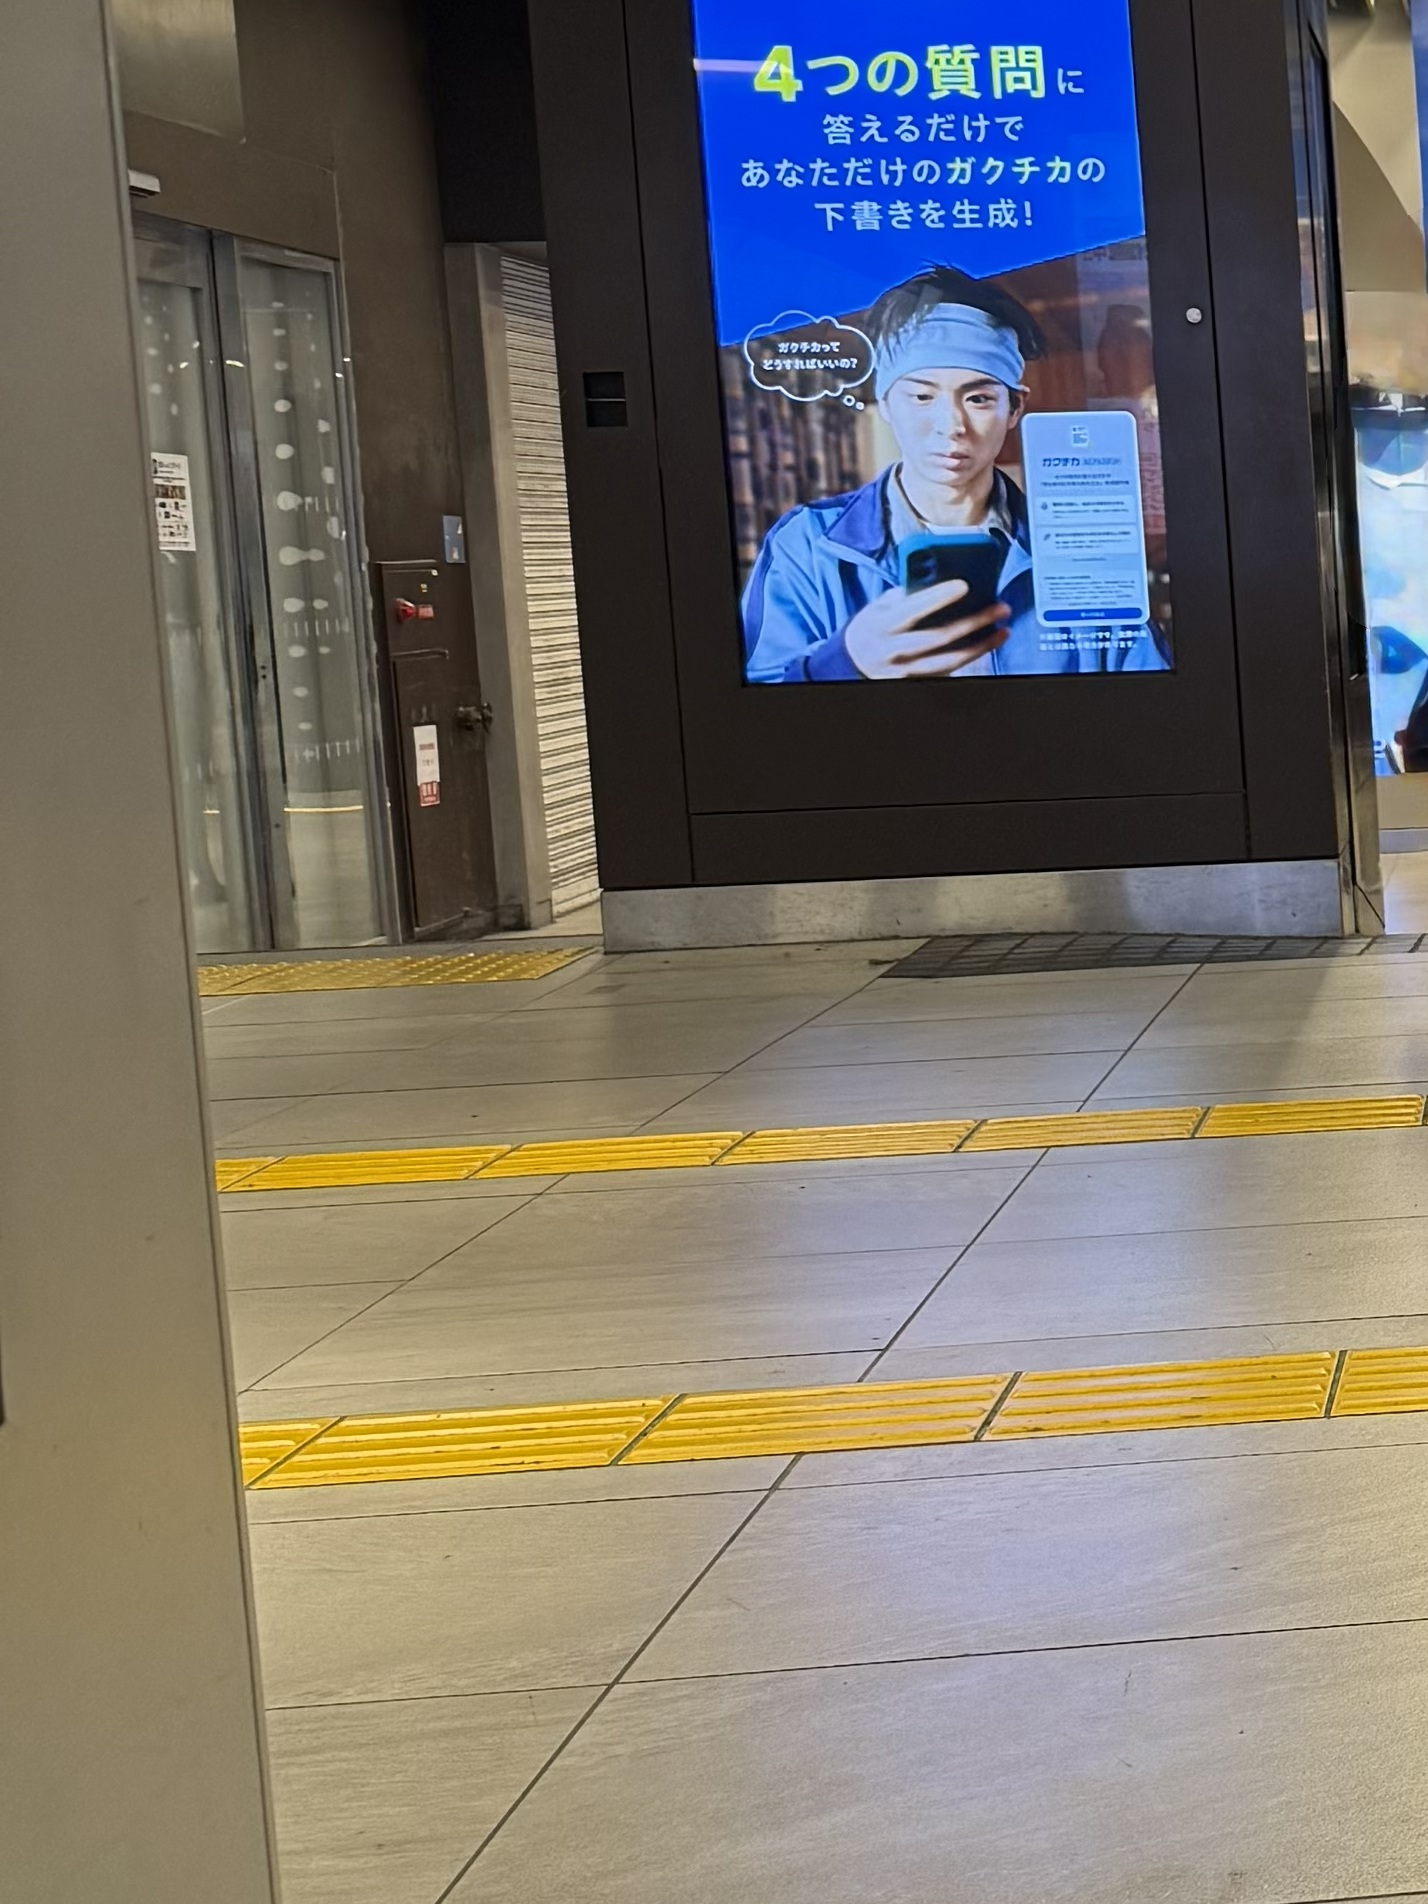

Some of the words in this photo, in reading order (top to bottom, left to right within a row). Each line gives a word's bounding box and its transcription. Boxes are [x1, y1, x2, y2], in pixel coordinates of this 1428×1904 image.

[753, 43, 1085, 103] 4つの質問に
[822, 112, 1024, 146] 答えるだけで
[741, 156, 1106, 189] あなただけのガクチカの
[814, 198, 1034, 232] 下書きを生成!
